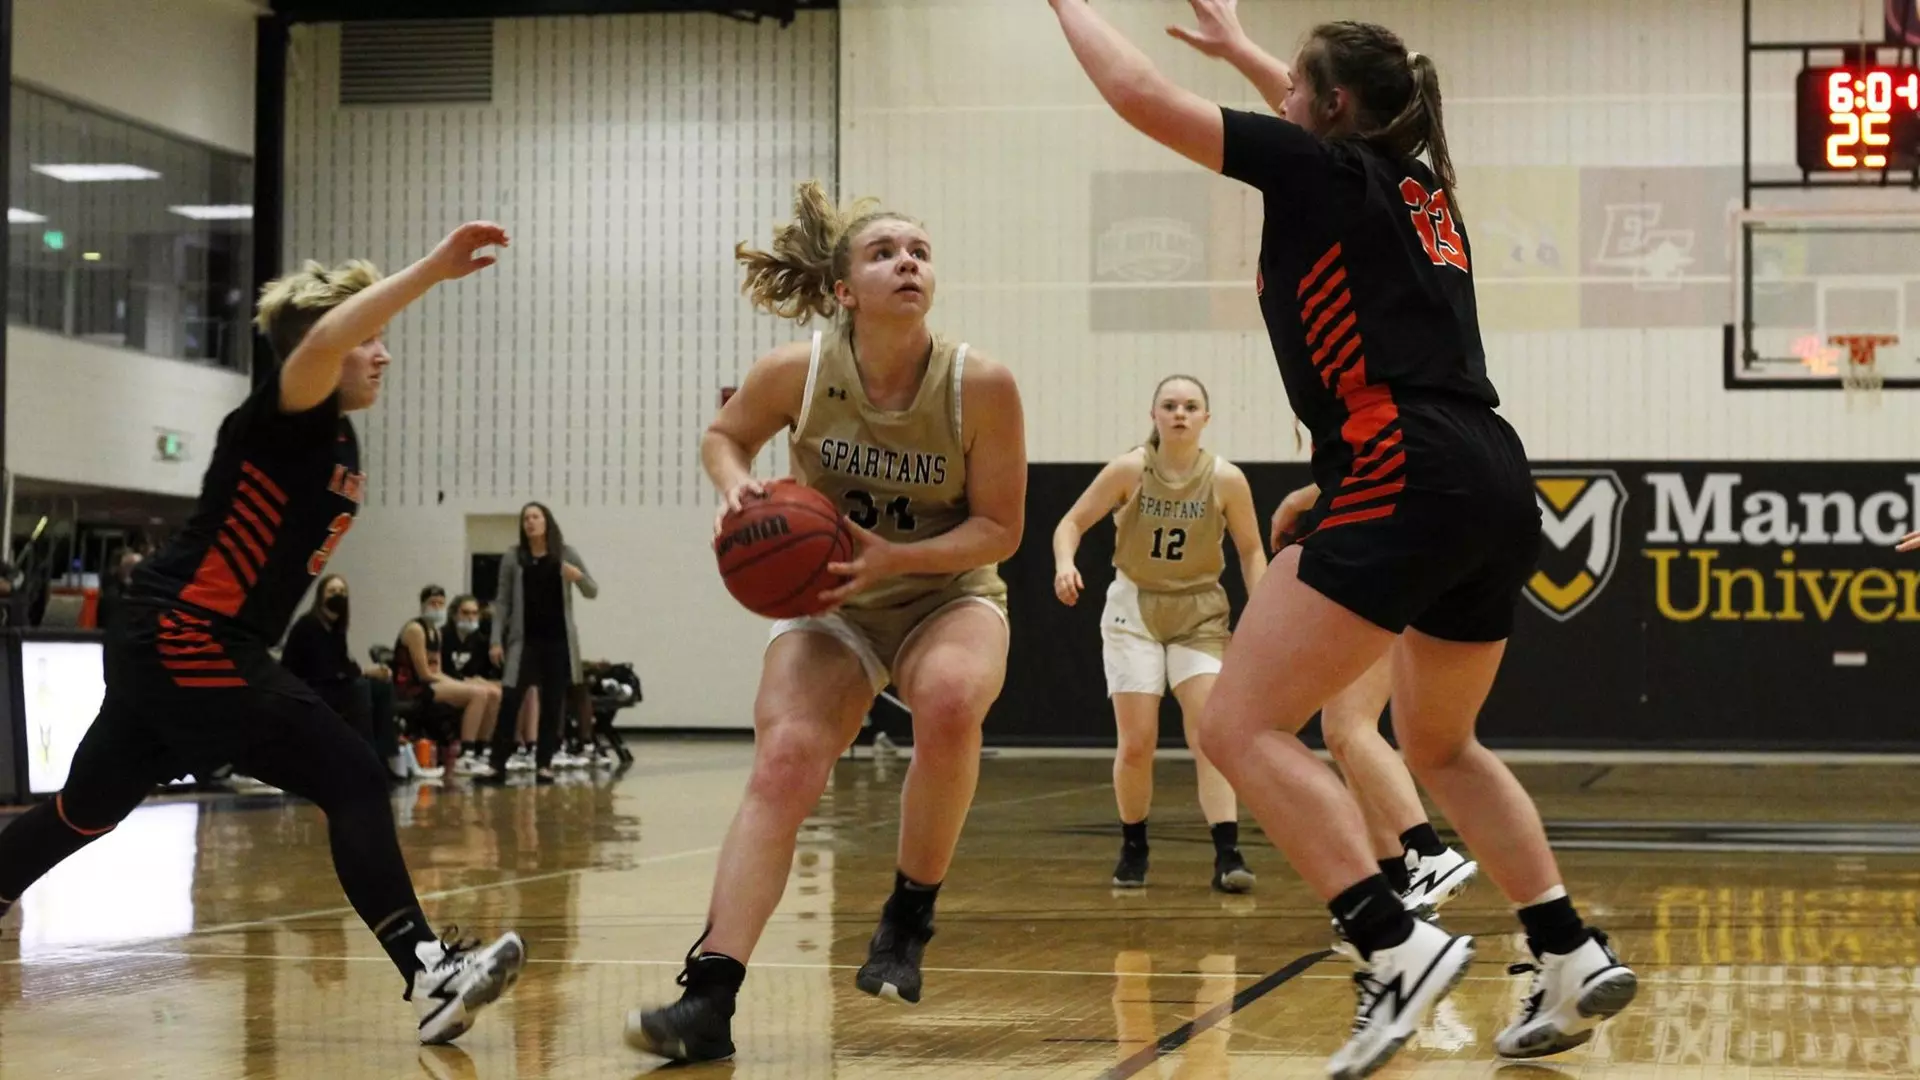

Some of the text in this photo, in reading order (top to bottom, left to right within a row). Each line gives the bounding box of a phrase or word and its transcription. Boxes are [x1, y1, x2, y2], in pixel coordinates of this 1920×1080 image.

[820, 437, 948, 486] SPARTANS
[1140, 494, 1206, 520] SPARTANS
[1149, 525, 1187, 562] 12
